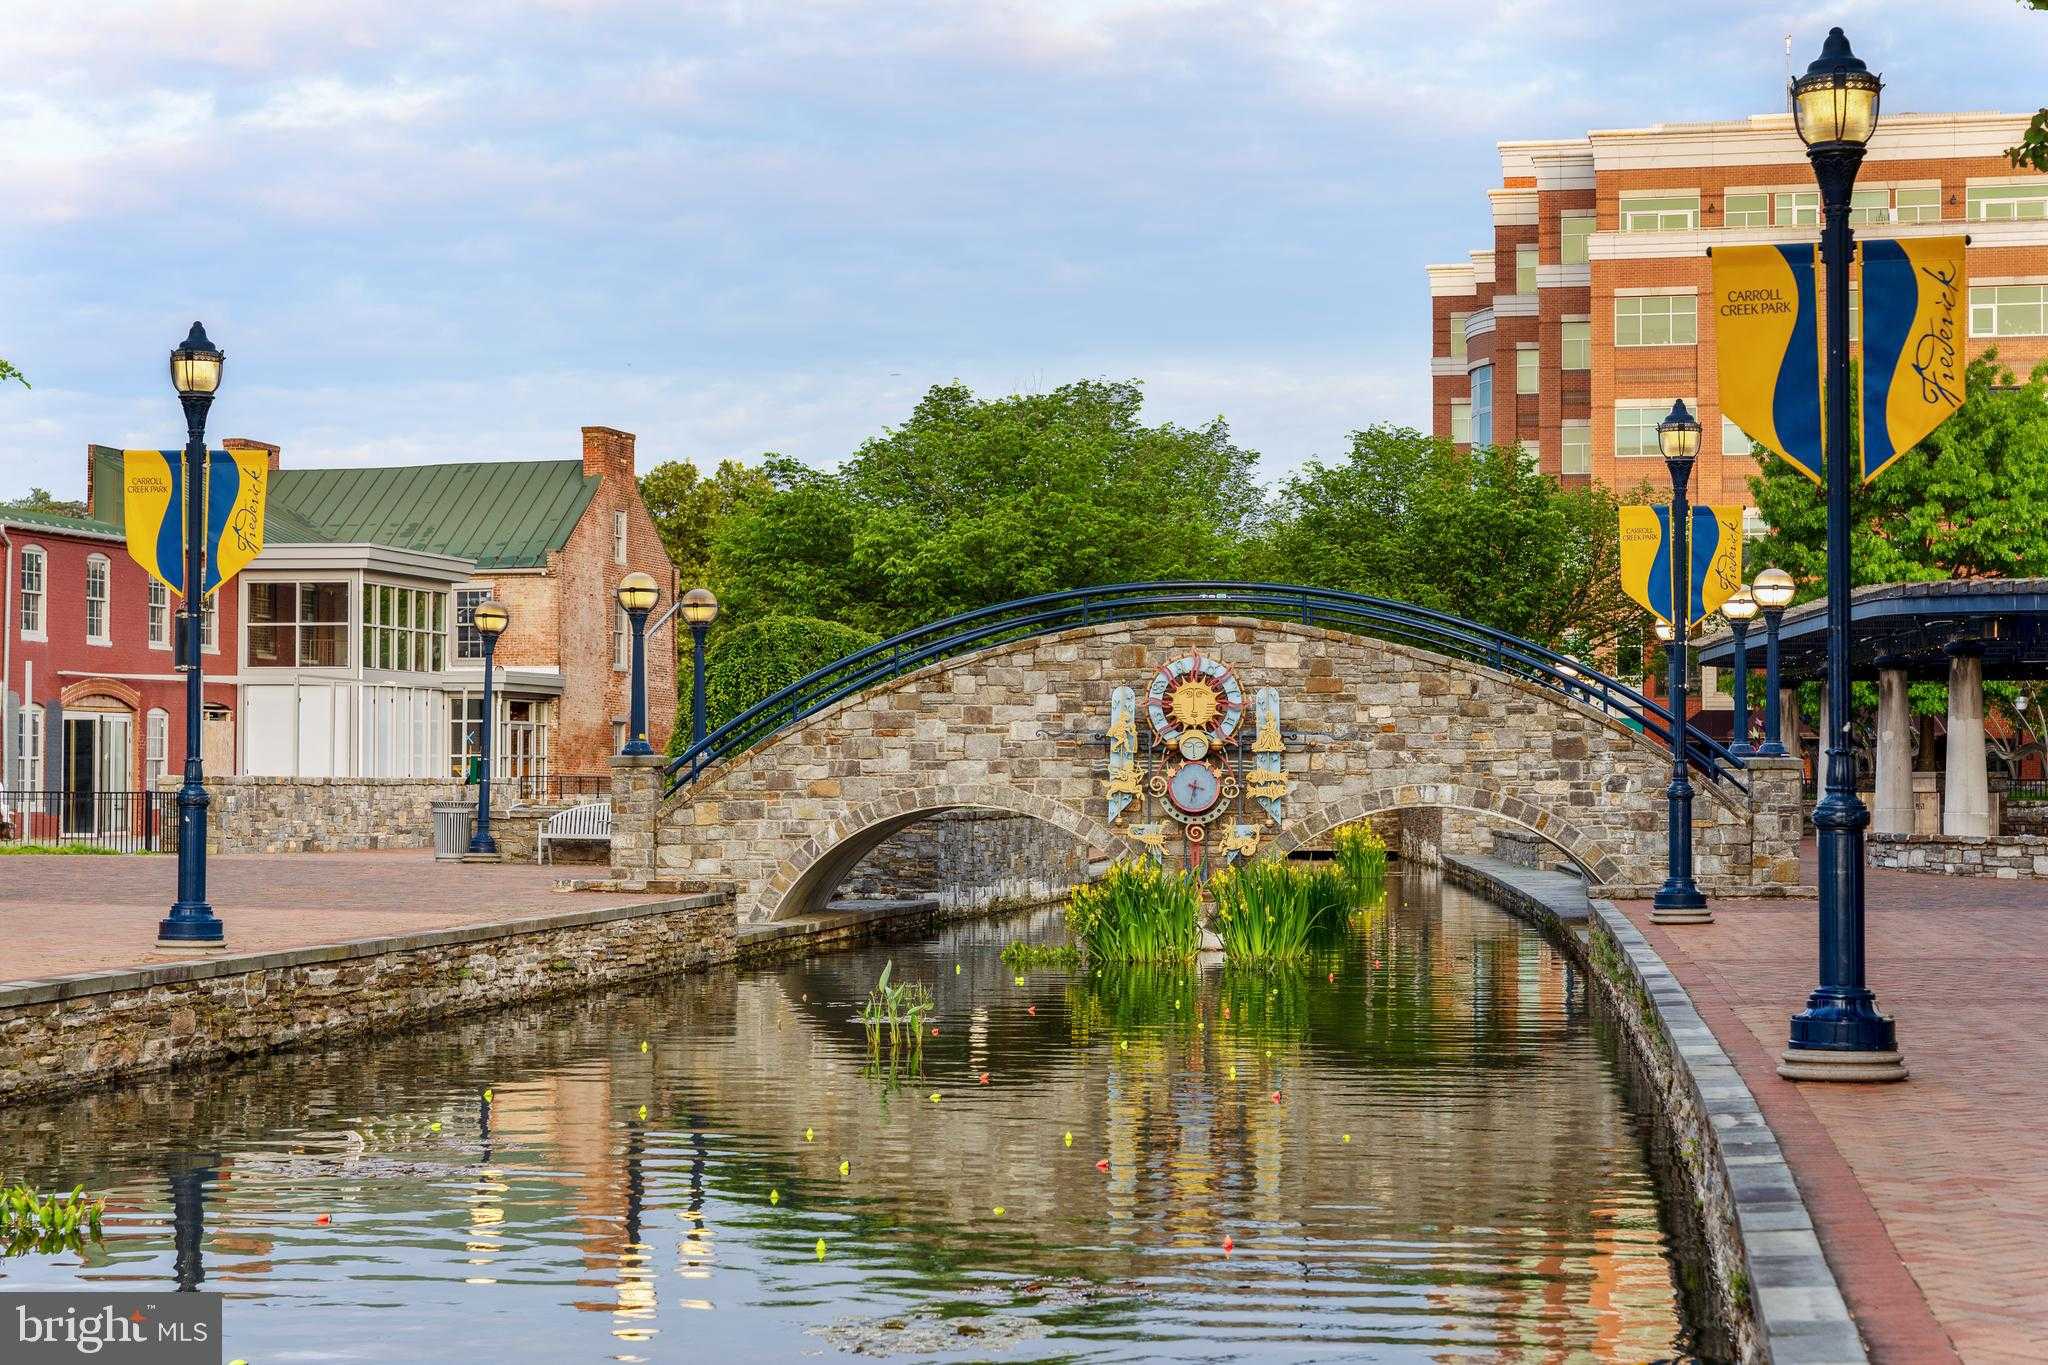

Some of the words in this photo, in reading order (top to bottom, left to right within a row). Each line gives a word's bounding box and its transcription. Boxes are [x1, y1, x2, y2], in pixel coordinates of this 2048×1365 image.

[1727, 288, 1783, 302] CARROLL
[1720, 303, 1759, 316] CREEK
[1761, 301, 1791, 314] PARK
[1911, 259, 1962, 408] Frederick
[131, 477, 163, 485] CARROLL
[127, 485, 149, 493] CREEK
[150, 485, 168, 493] PARK
[231, 465, 263, 553] Frederick
[1715, 517, 1741, 594] Frederick
